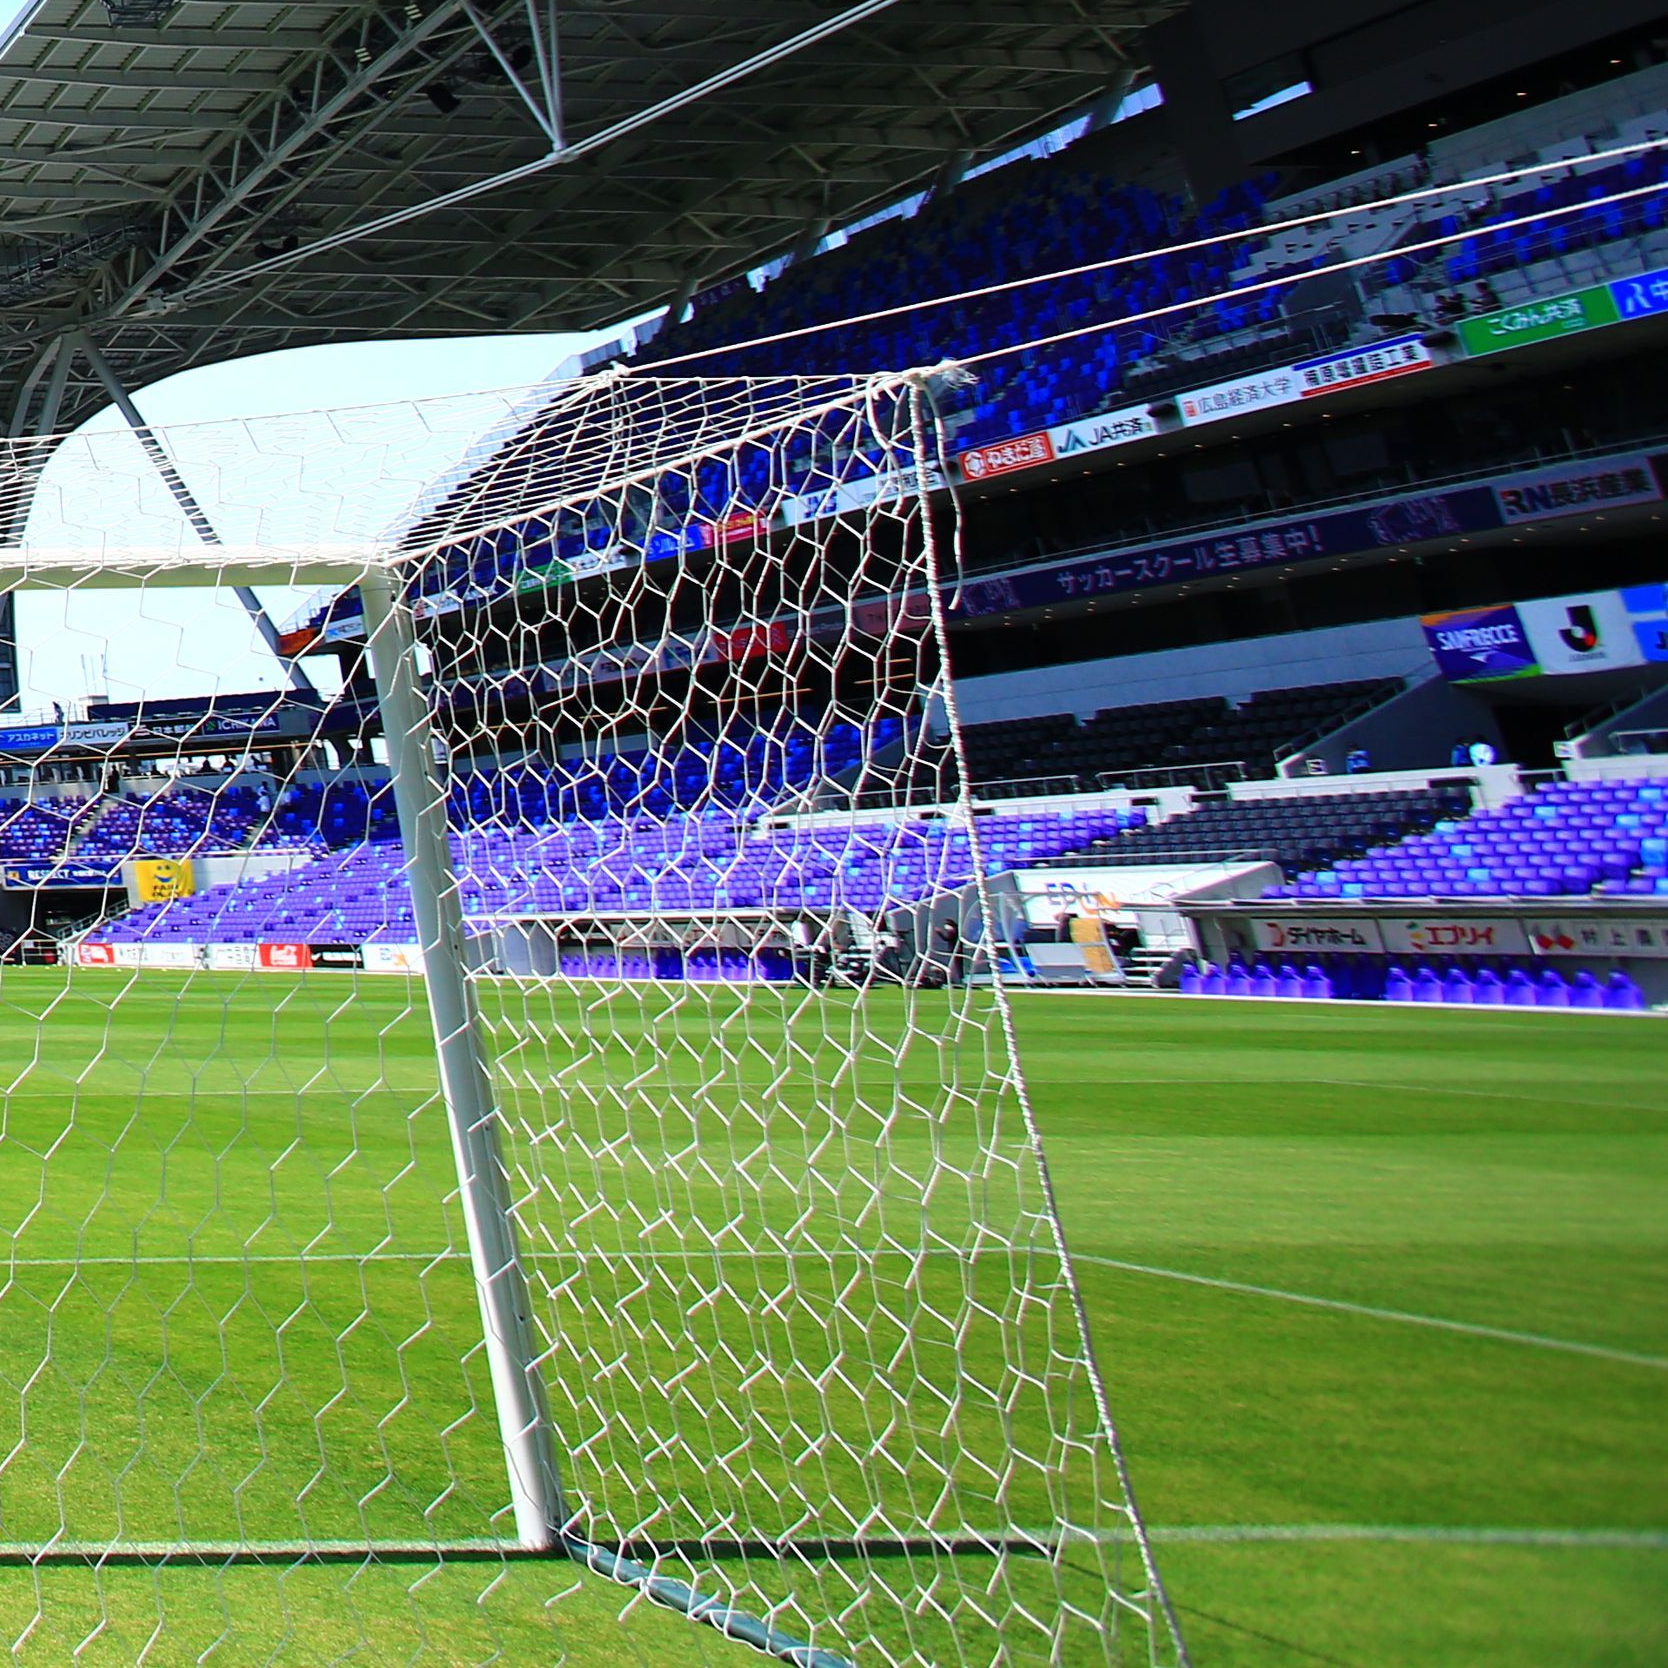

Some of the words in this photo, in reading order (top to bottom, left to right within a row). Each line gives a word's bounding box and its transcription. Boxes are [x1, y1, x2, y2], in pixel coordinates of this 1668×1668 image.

[7, 733, 54, 744] アスカネット
